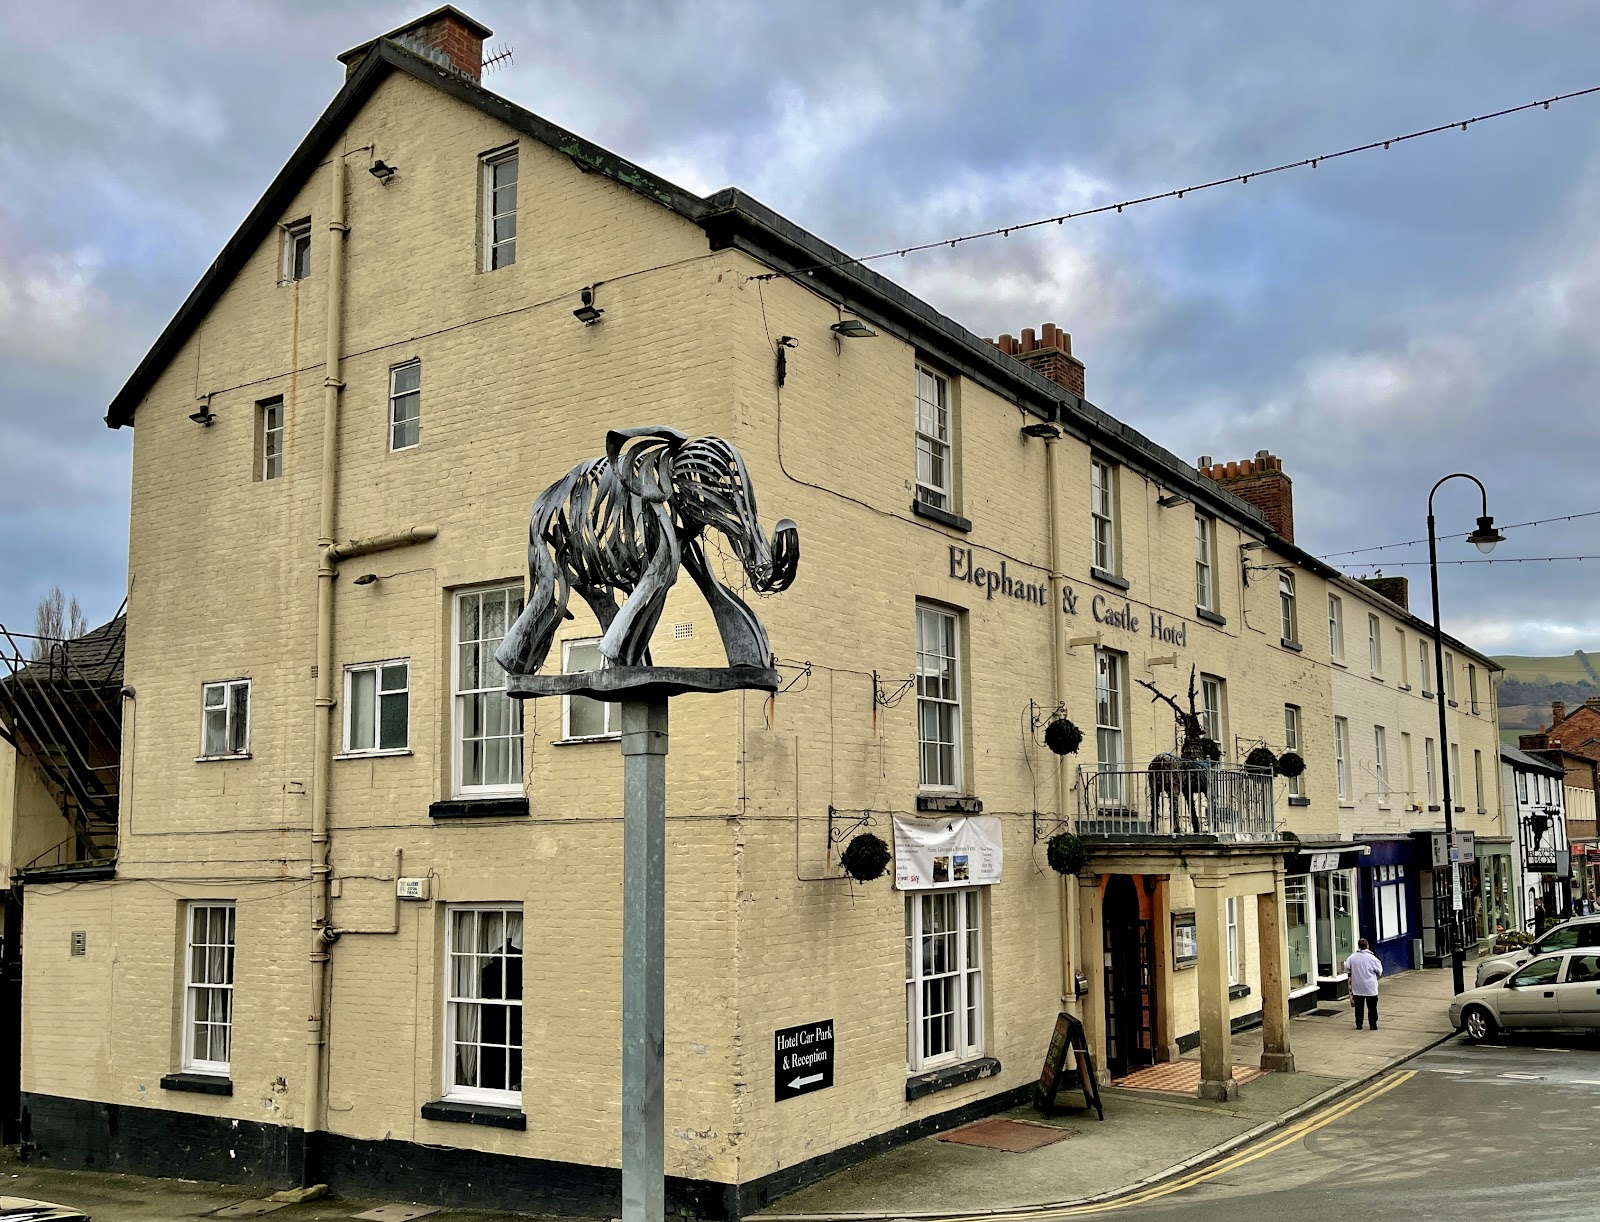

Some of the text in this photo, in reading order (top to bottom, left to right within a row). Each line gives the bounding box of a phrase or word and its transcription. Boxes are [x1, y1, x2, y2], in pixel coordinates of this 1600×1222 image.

[948, 544, 1187, 647] Elephant & Castle Hotel
[777, 1025, 832, 1051] Hotel Car Park
[782, 1048, 827, 1070] & Reception
